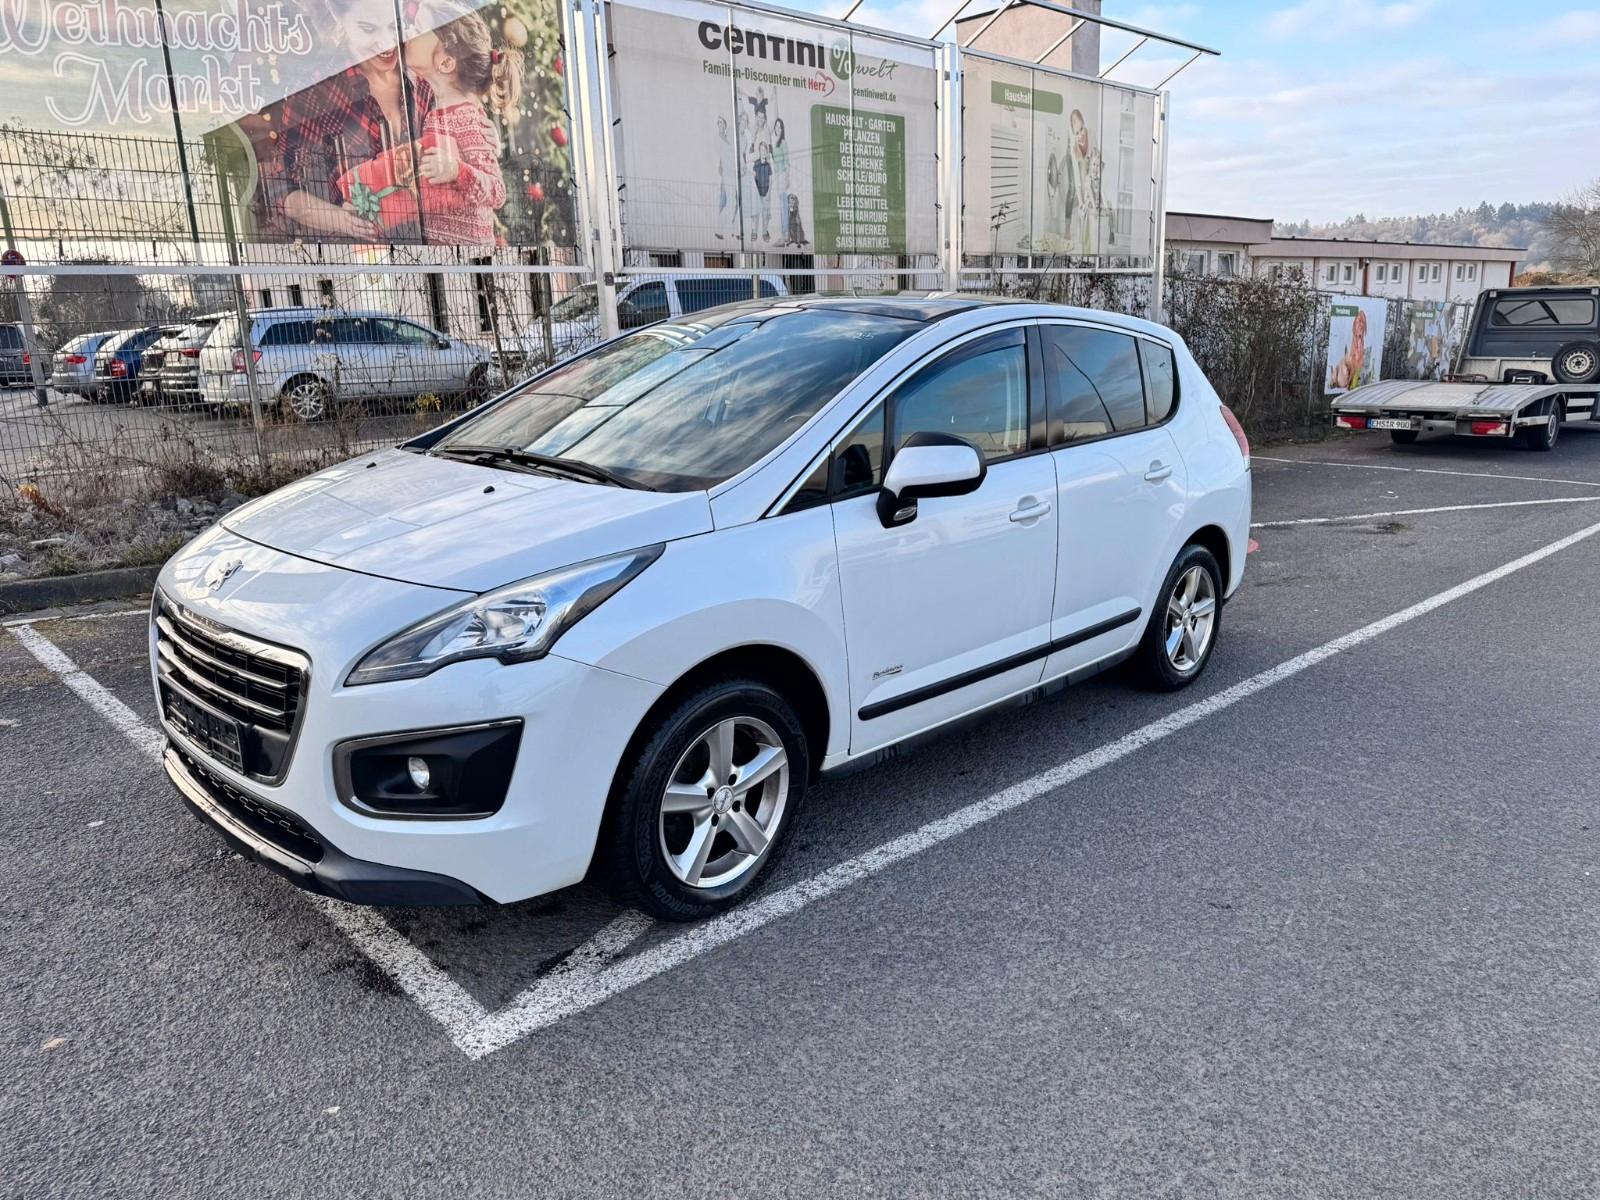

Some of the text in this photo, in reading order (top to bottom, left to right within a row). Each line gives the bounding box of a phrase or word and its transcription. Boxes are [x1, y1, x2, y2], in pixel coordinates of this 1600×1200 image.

[856, 59, 899, 80] welt
[45, 52, 265, 126] Markt
[793, 76, 806, 89] mit
[808, 79, 826, 92] Herz
[852, 87, 896, 103] centiniwelt.de
[868, 118, 896, 133] GARTEN
[841, 155, 884, 170] GECHENKE
[836, 195, 888, 210] LEBENSMITTEL
